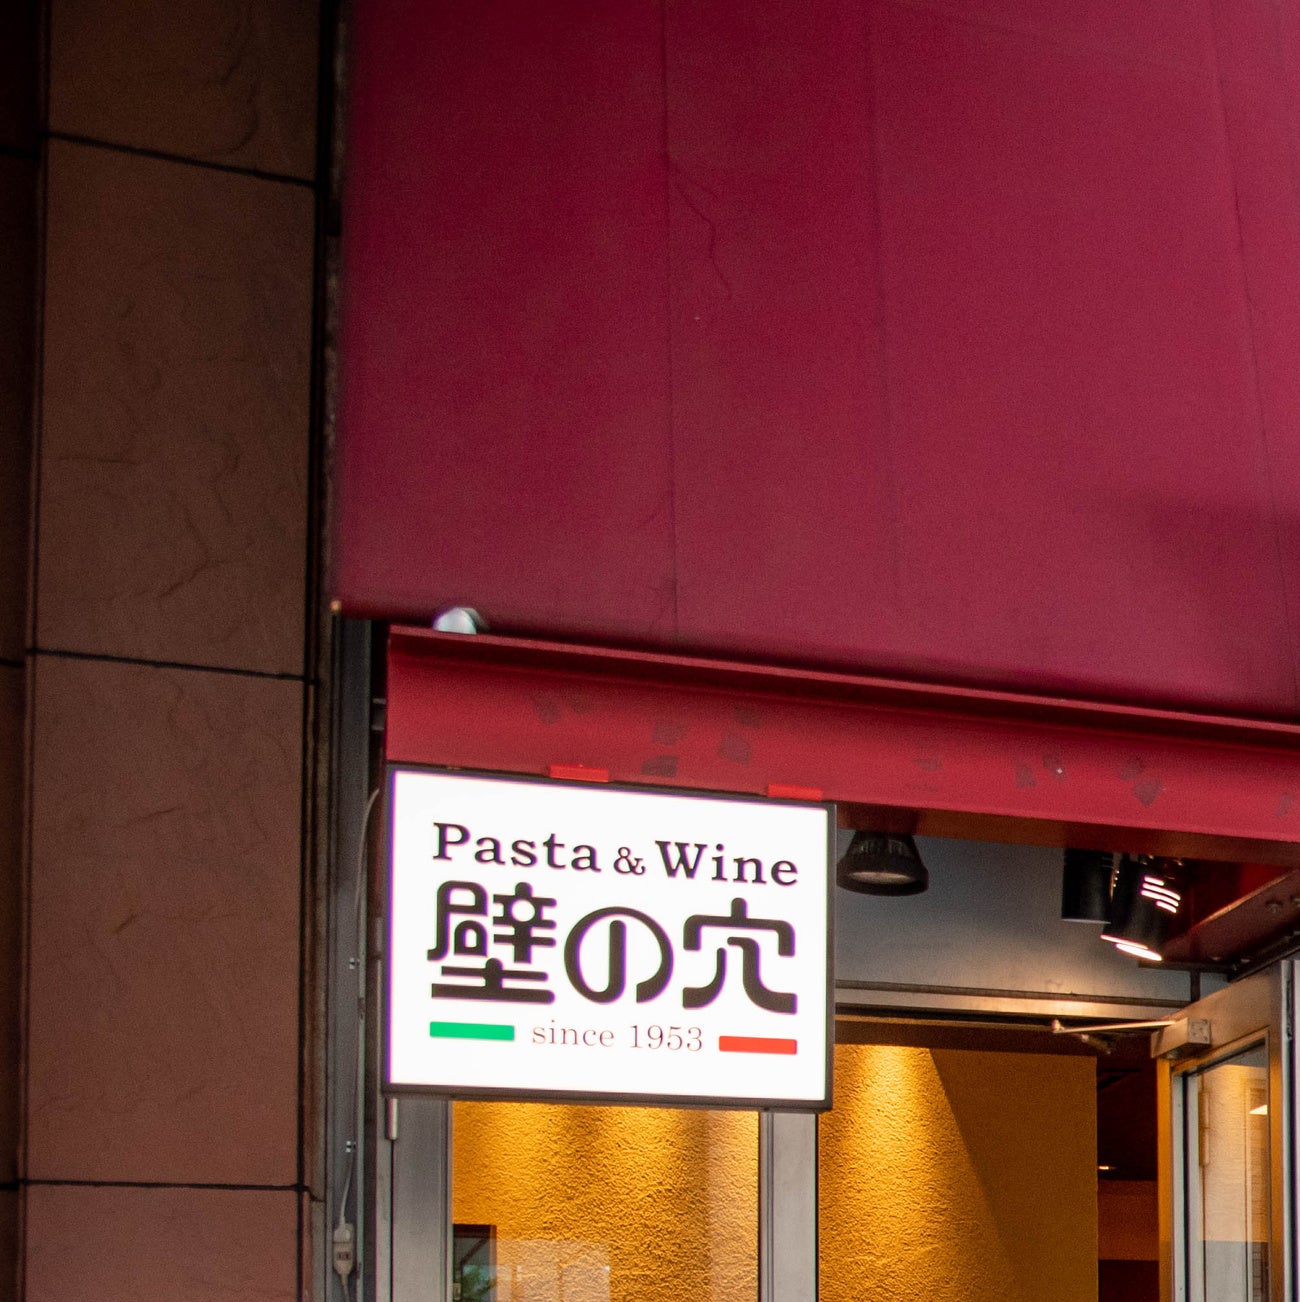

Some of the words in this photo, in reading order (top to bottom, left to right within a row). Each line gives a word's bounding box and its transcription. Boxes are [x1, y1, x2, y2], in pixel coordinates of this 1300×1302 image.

[432, 822, 601, 872] Pasta
[613, 846, 646, 876] &
[655, 840, 798, 886] Wine
[426, 880, 798, 1015] 壁の穴
[532, 1019, 615, 1048] since
[630, 1024, 703, 1052] 1953
